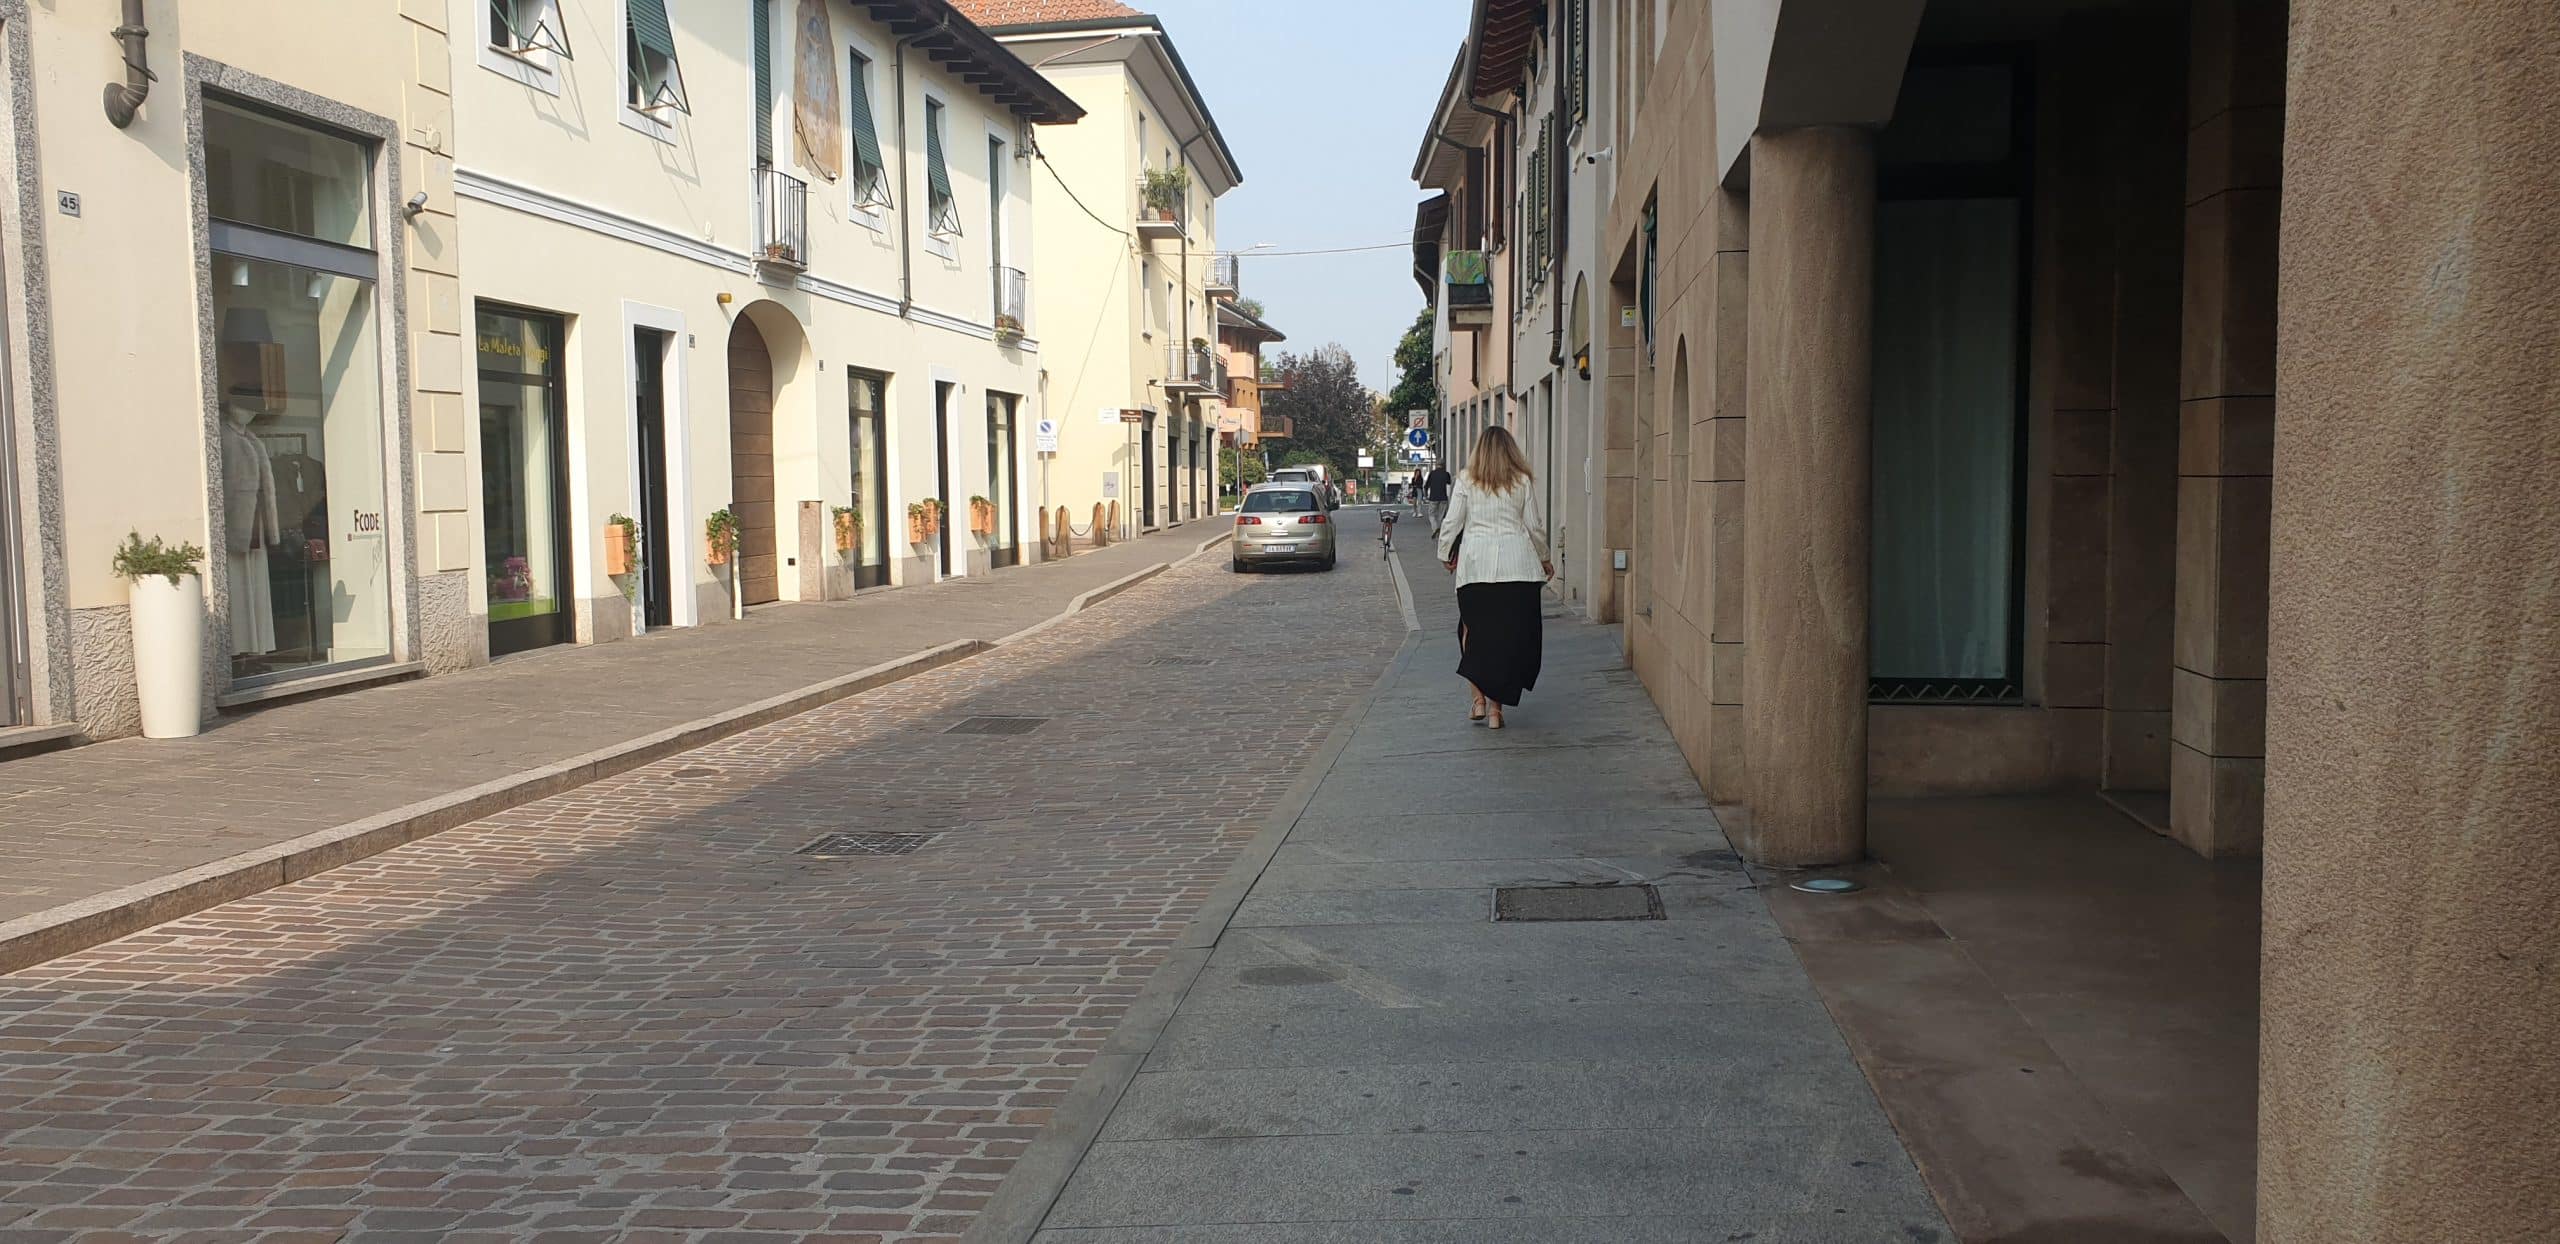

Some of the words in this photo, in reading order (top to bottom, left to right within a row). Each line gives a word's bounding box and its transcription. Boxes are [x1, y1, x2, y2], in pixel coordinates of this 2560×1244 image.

[60, 196, 76, 210] 45
[478, 335, 489, 352] La
[490, 335, 521, 356] Maleta
